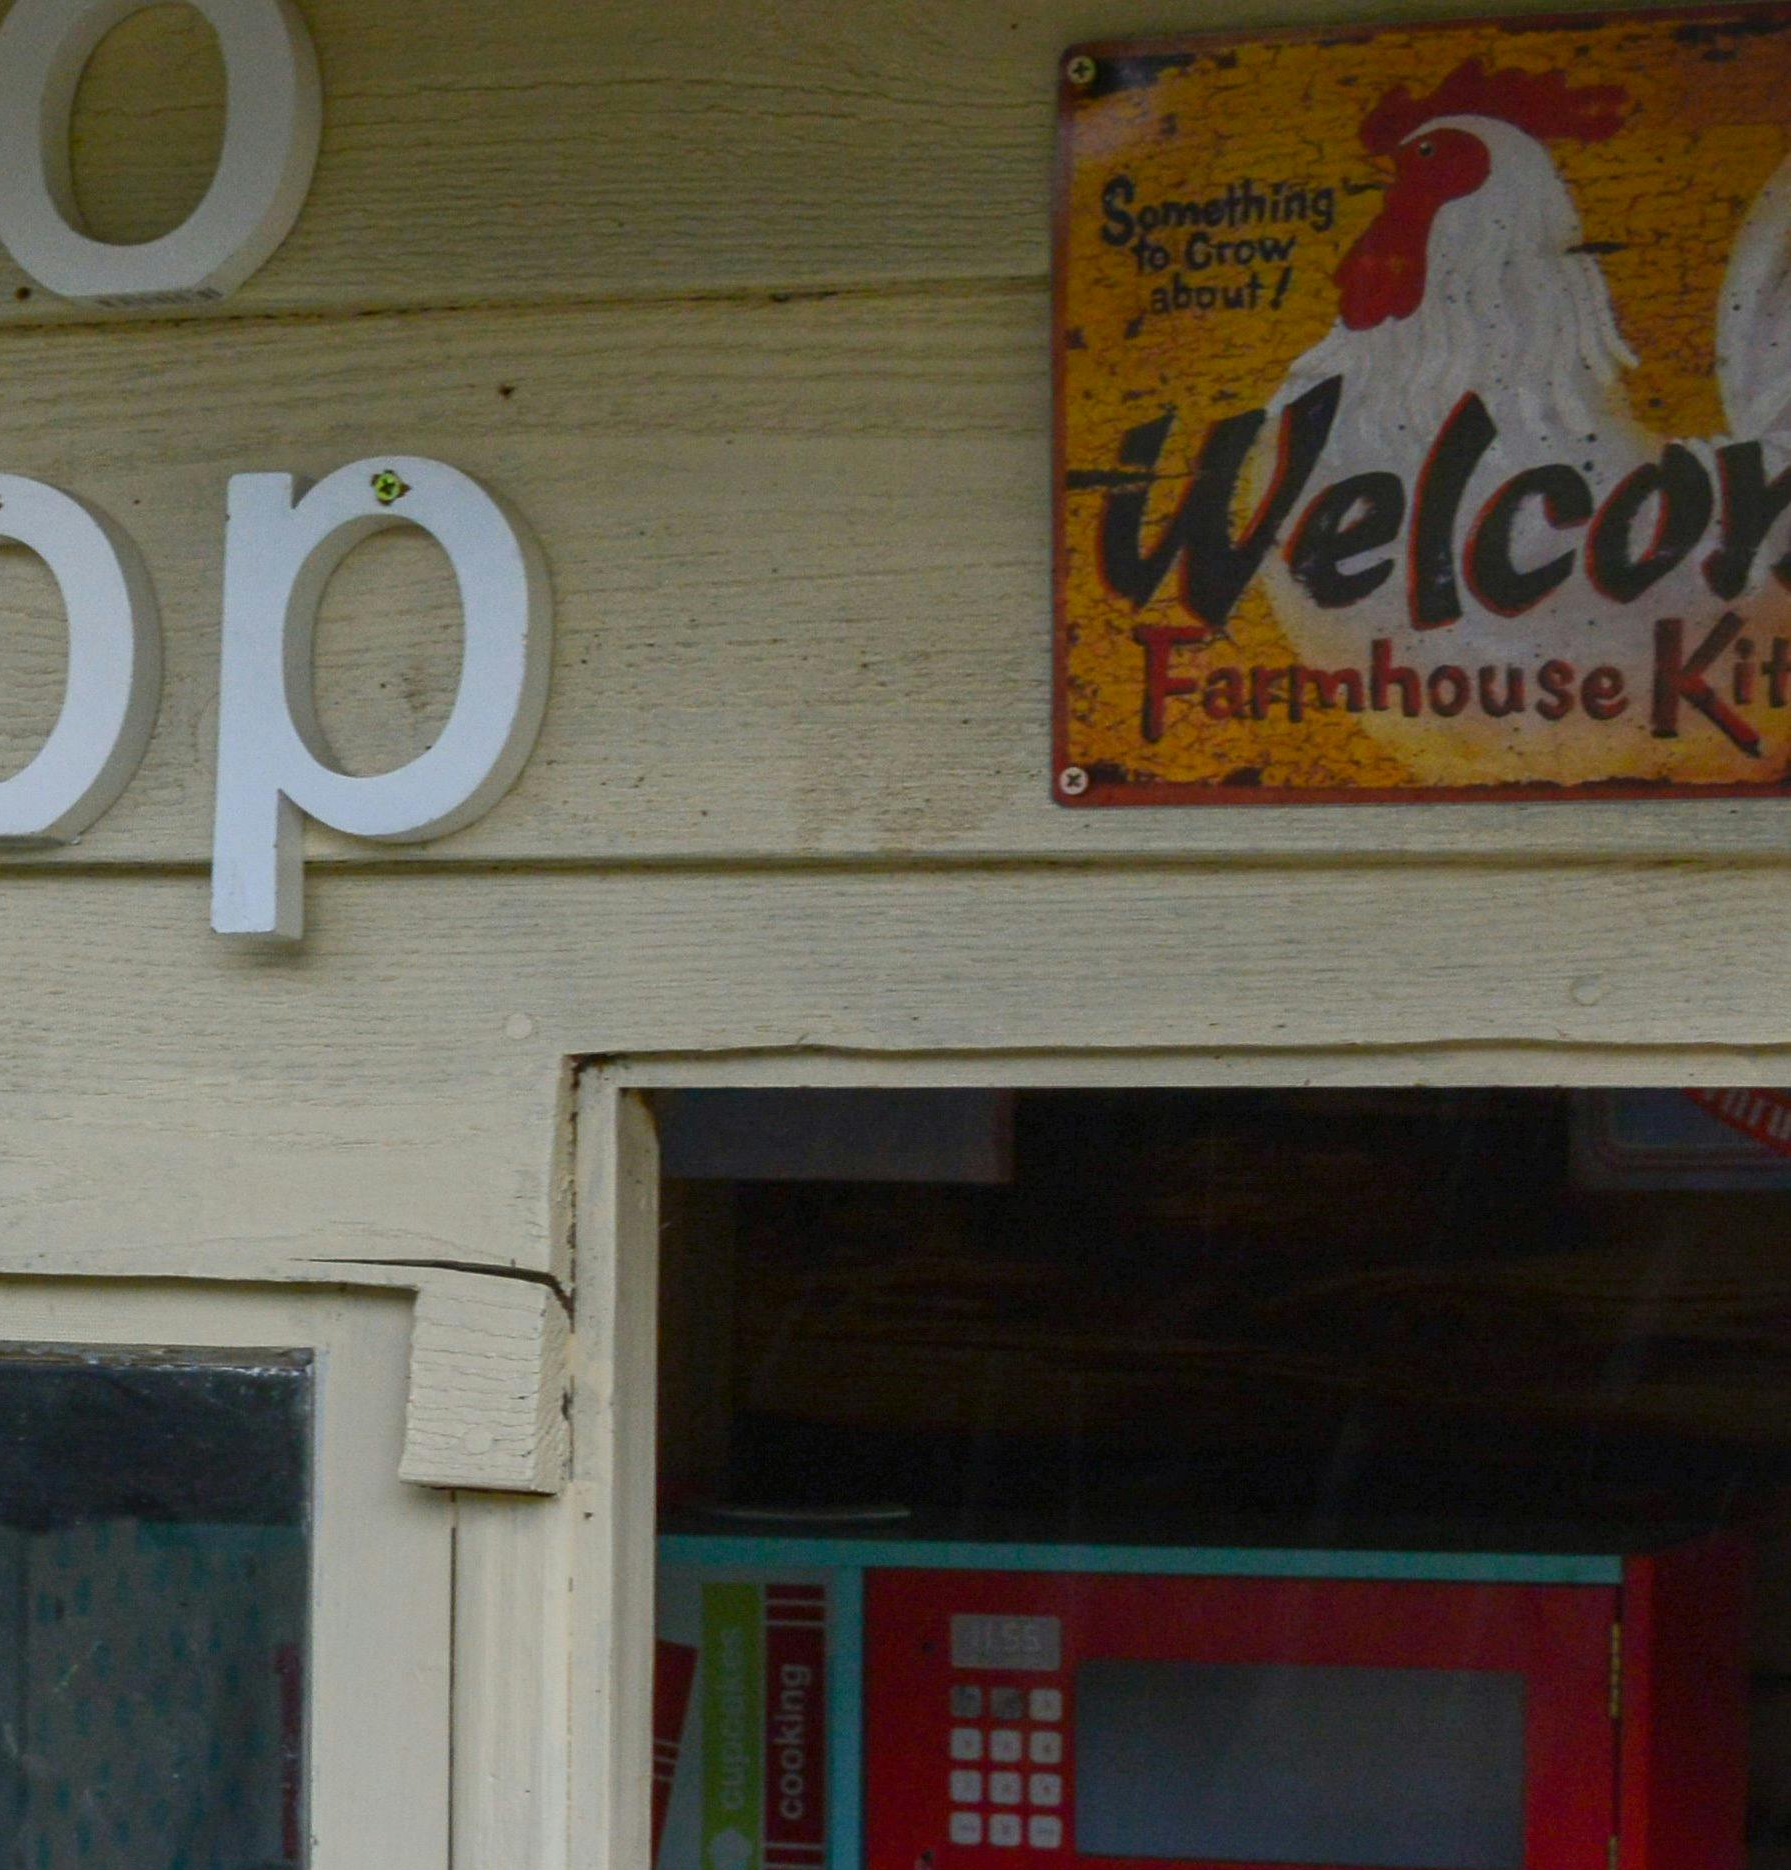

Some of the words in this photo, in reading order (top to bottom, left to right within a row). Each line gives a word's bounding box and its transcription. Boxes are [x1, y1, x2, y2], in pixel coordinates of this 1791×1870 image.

[1101, 174, 1336, 248] Something
[1134, 235, 1172, 274] to
[1185, 233, 1295, 270] Crow
[1150, 267, 1294, 315] about!
[1133, 624, 1629, 744] Farmhouse
[774, 1662, 812, 1821] cooking
